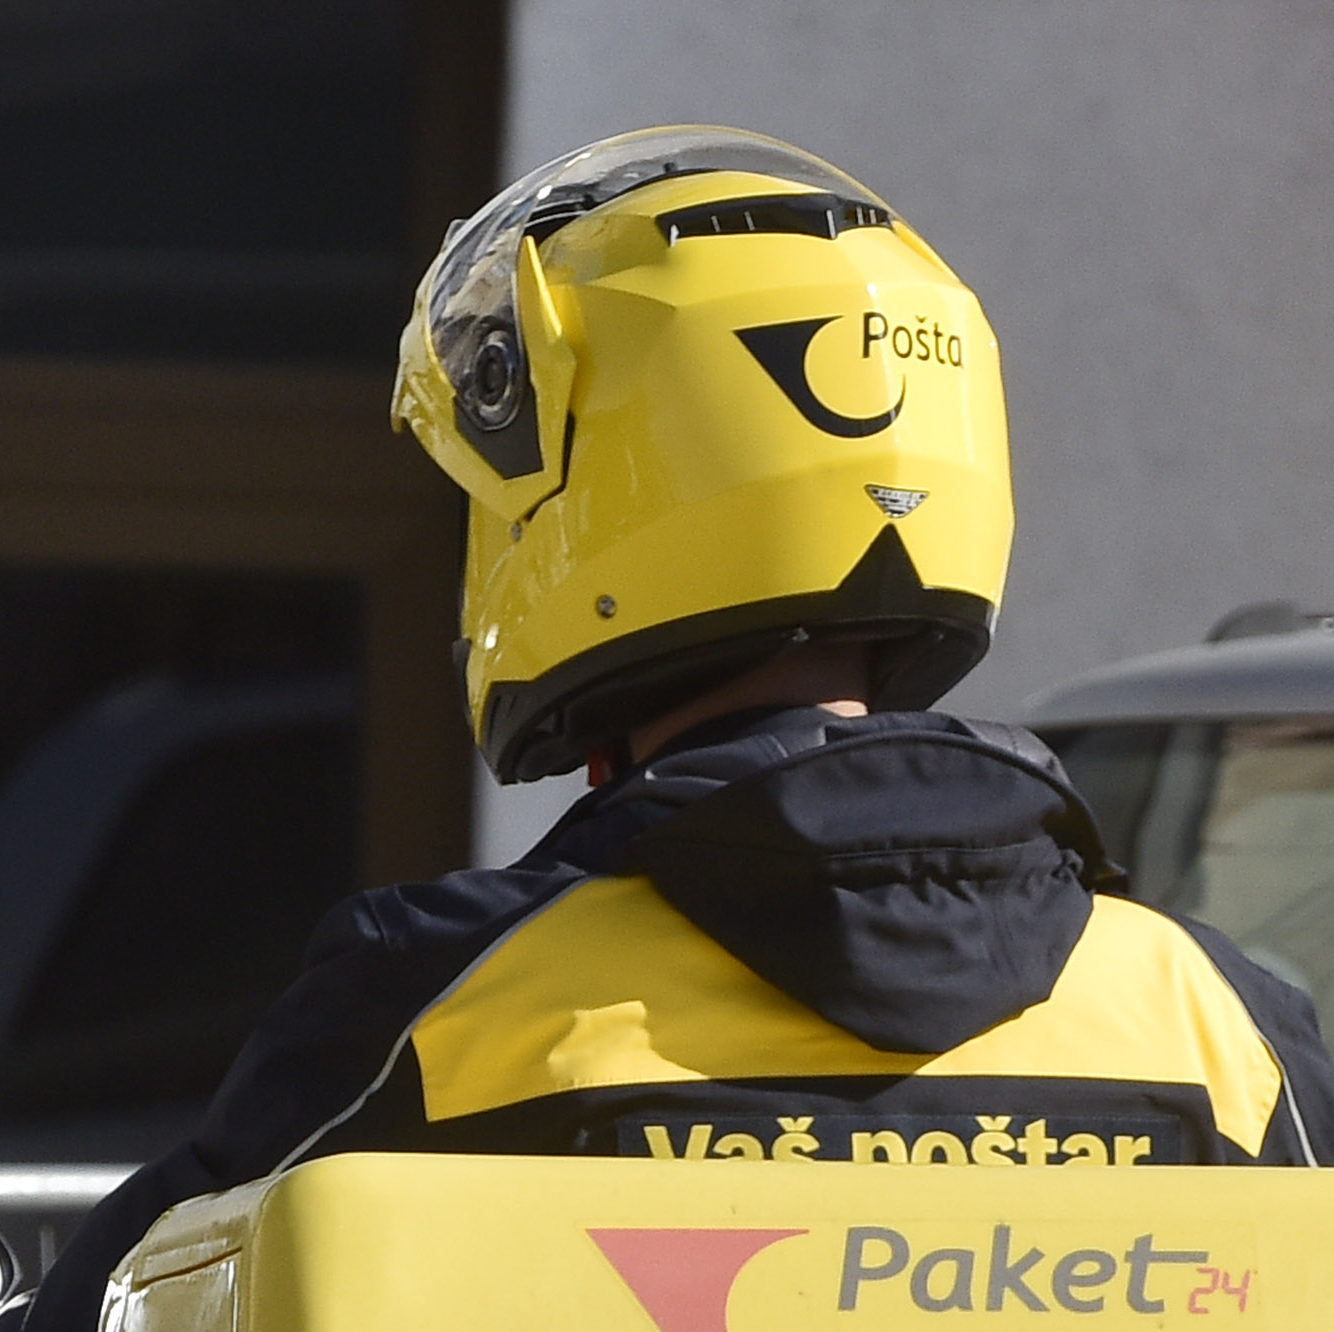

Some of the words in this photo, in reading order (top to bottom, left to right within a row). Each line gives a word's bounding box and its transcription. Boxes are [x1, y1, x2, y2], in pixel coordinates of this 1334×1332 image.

[862, 311, 963, 368] Pošta
[837, 1225, 1209, 1313] Paket
[1188, 1267, 1251, 1314] 24
